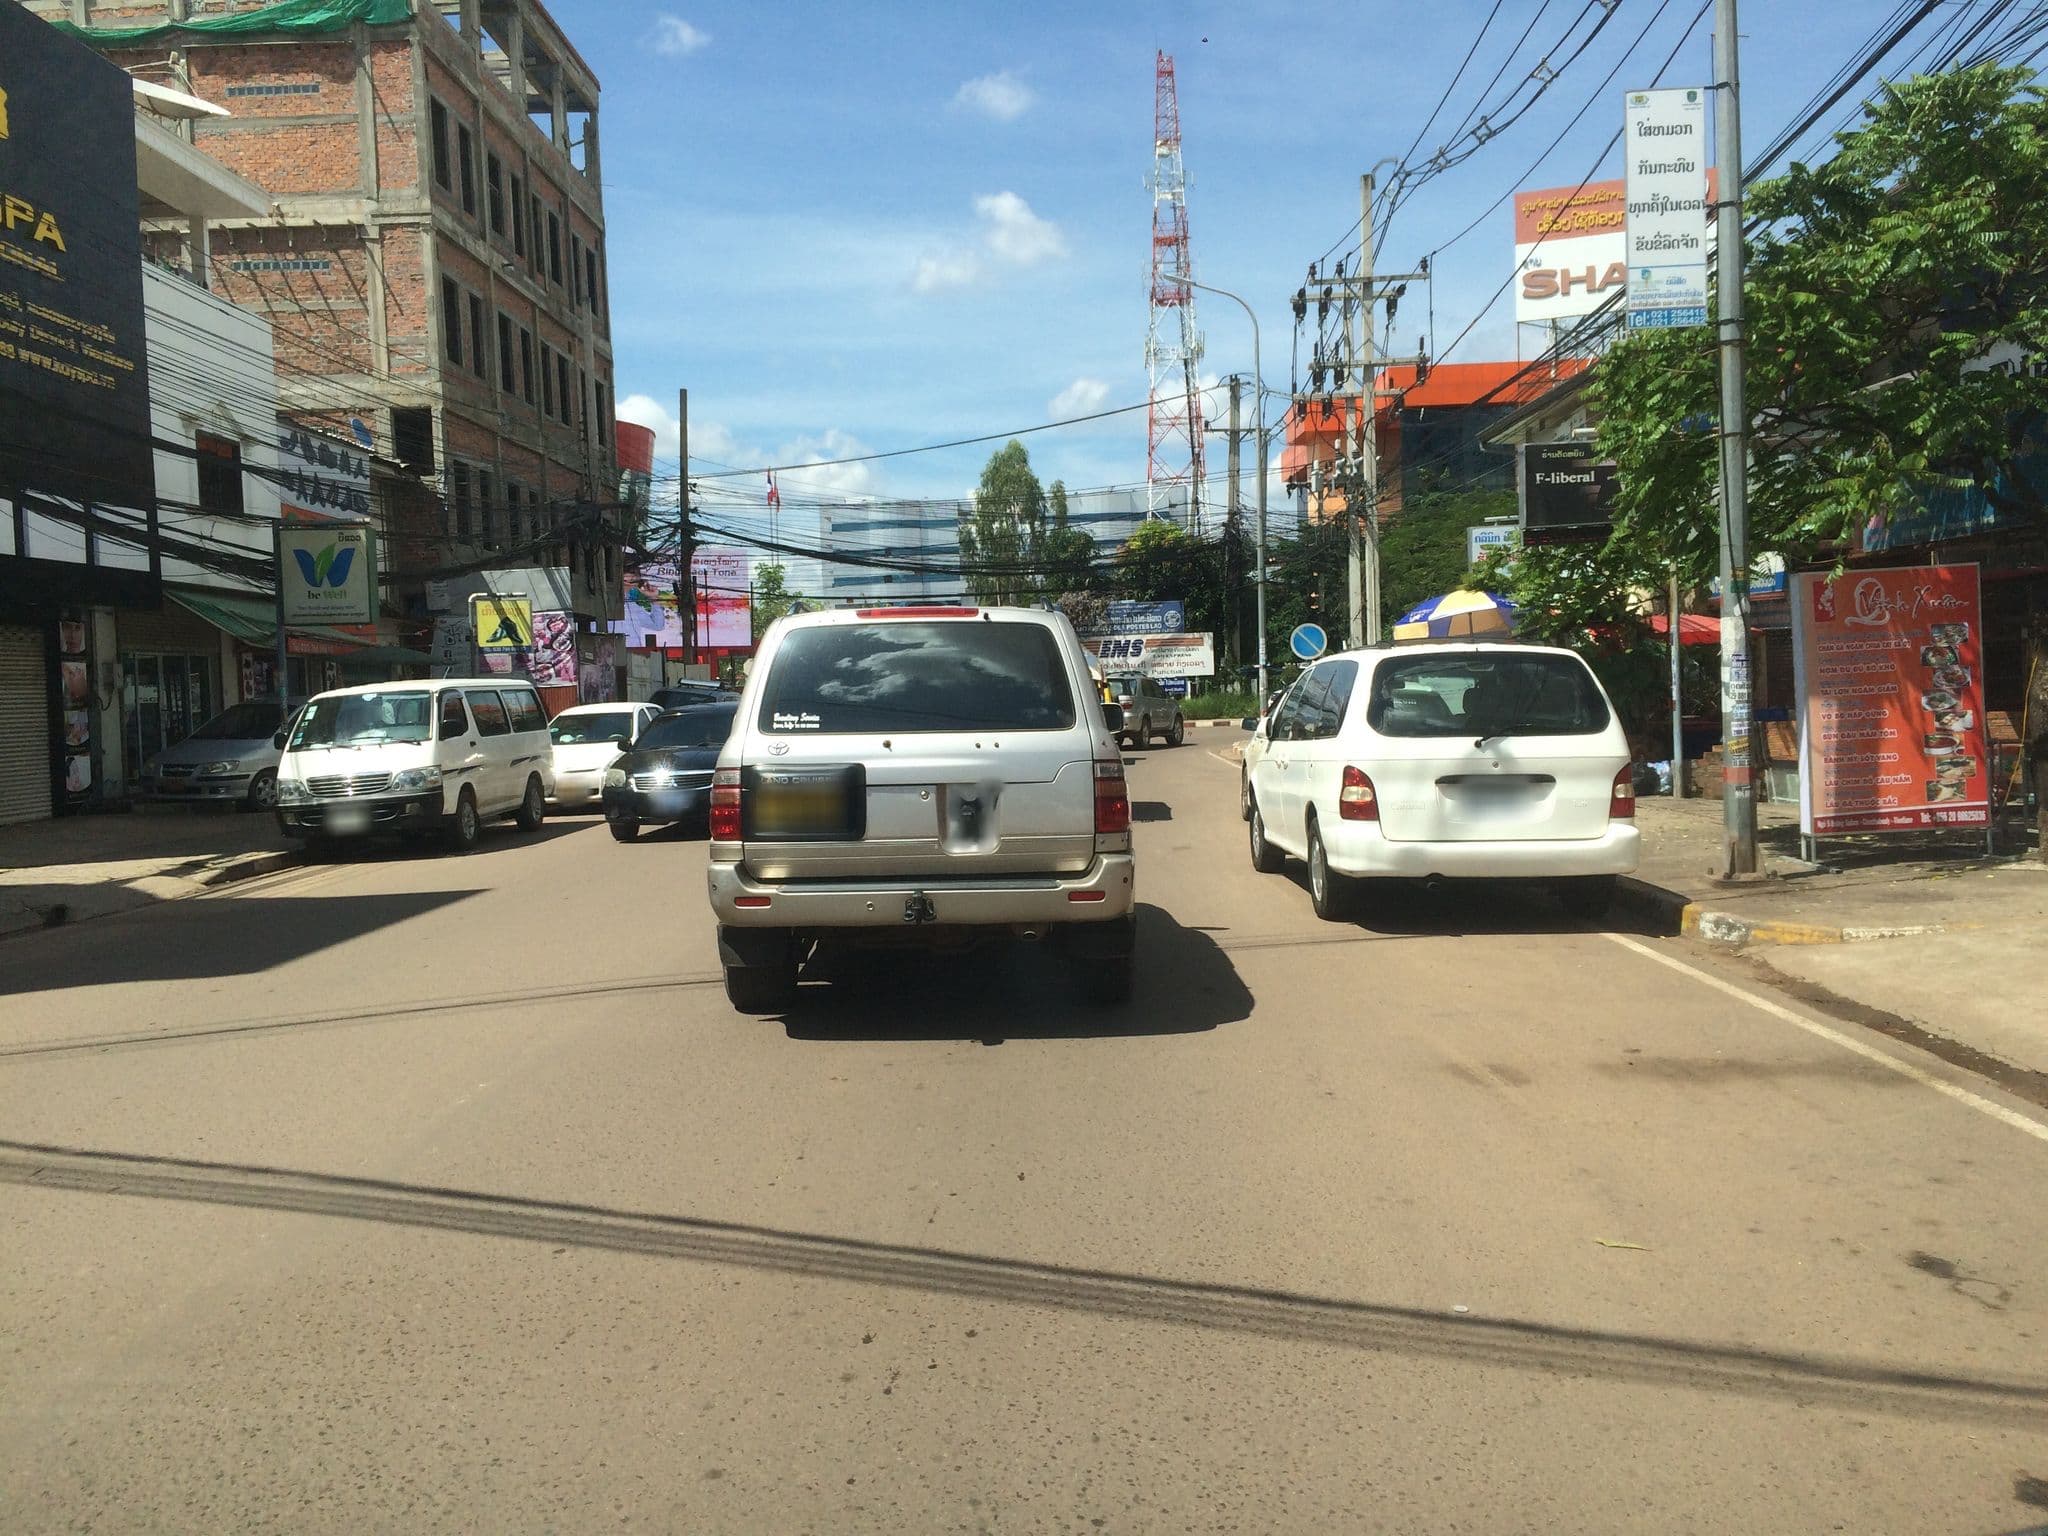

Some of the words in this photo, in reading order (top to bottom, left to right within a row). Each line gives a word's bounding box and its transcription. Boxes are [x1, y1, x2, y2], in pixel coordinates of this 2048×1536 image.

[0, 194, 66, 252] PA
[1629, 312, 1650, 327] Tel:
[1536, 470, 1596, 485] F-liberal
[713, 568, 737, 577] Tone
[307, 590, 321, 600] be
[1100, 639, 1144, 658] EMS
